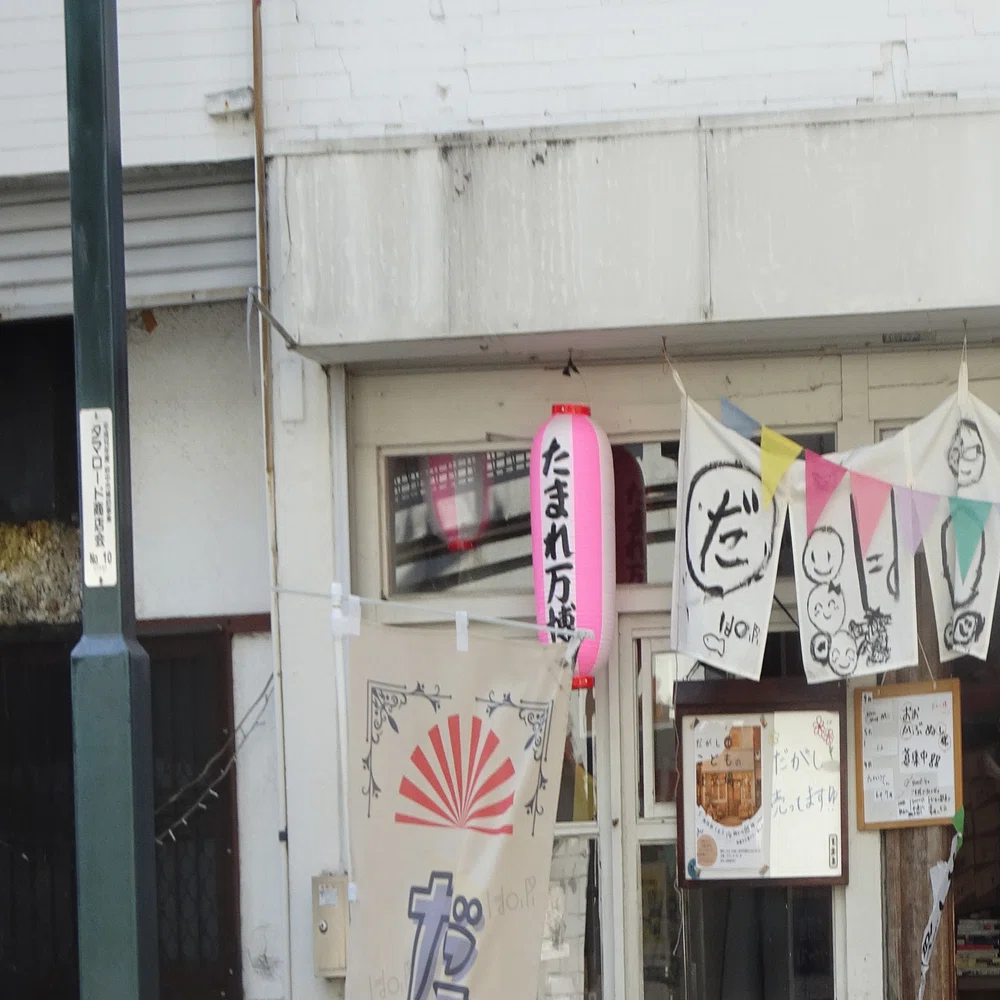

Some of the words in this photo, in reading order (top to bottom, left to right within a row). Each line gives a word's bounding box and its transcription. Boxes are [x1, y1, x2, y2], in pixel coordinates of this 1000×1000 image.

[91, 423, 105, 548] タマロード商店会
[102, 550, 112, 565] 10
[700, 488, 760, 574] だ
[773, 748, 824, 776] だがし
